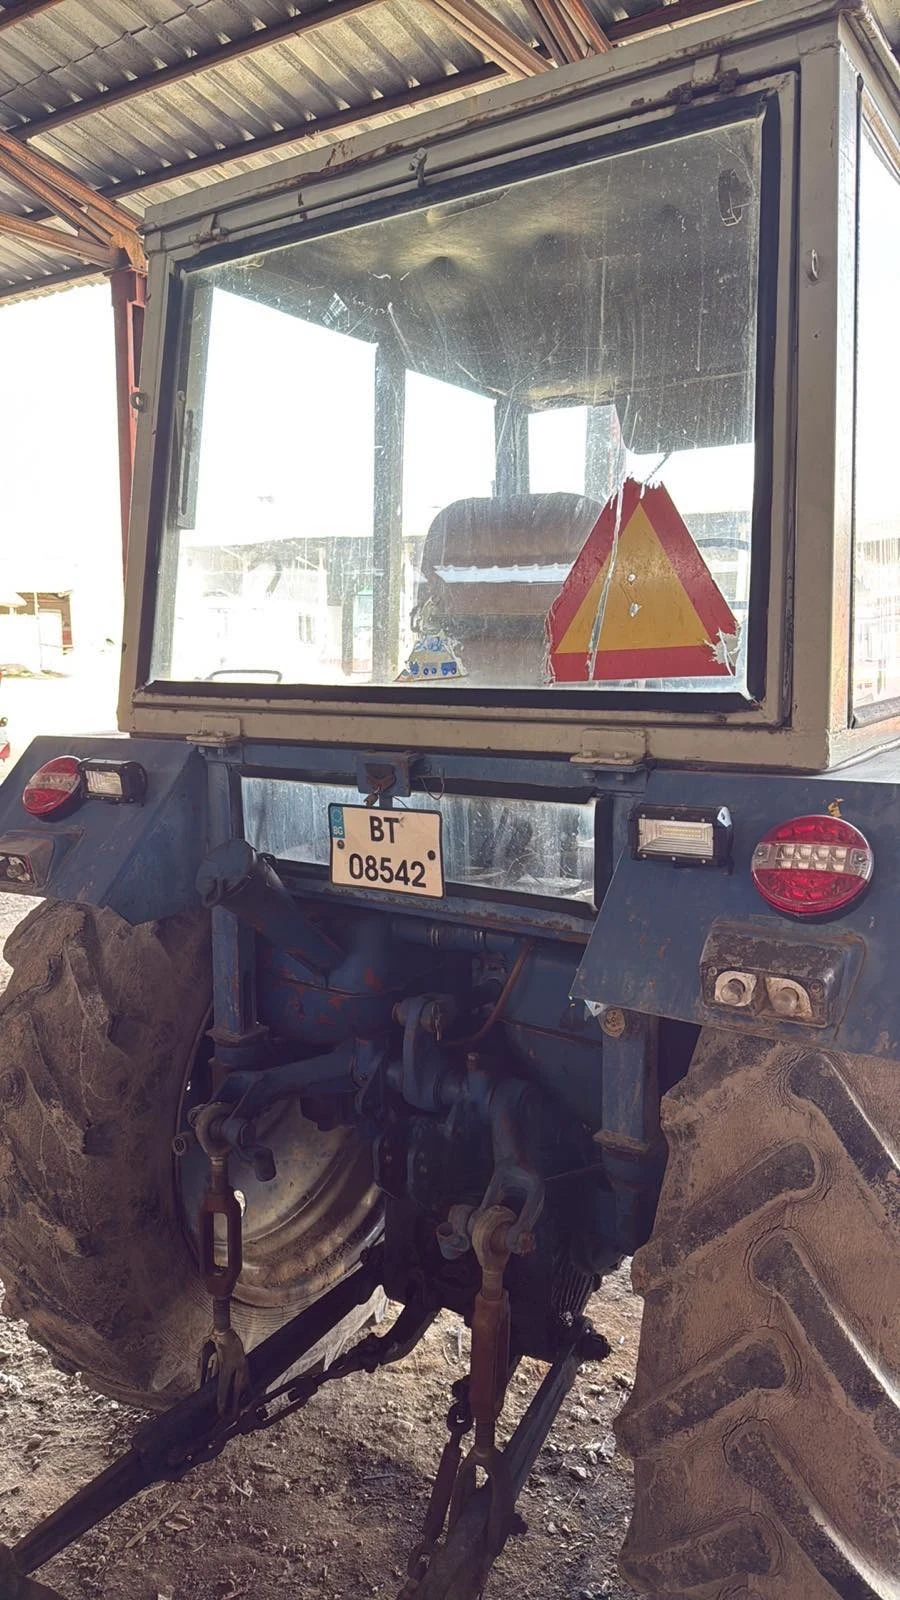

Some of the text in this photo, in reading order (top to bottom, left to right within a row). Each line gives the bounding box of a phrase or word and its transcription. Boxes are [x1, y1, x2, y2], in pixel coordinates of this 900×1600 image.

[332, 826, 344, 835] BG
[369, 815, 400, 844] BT
[349, 853, 427, 888] 08542
